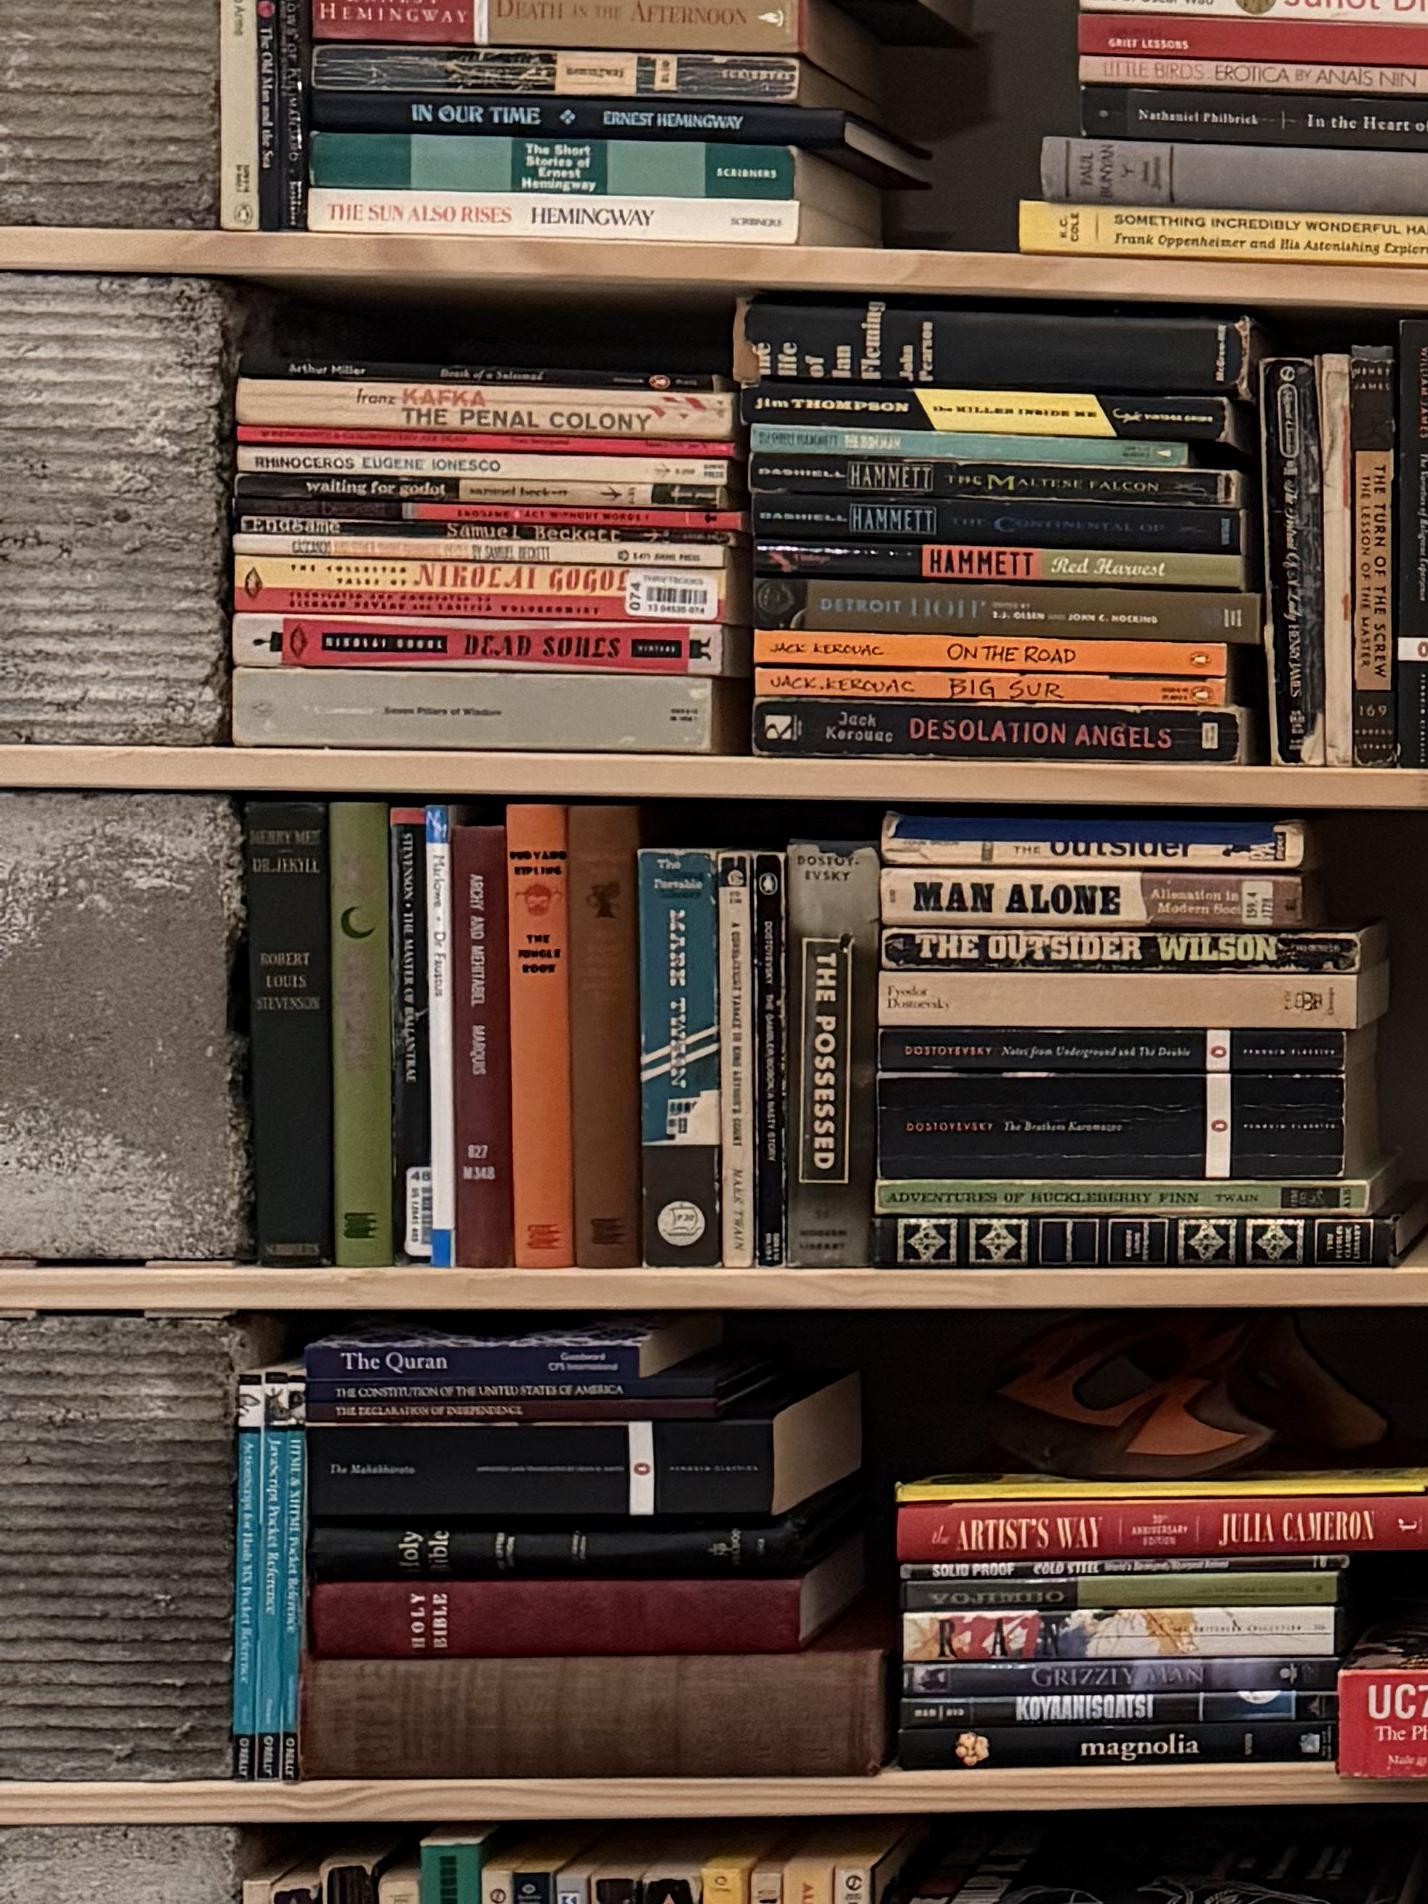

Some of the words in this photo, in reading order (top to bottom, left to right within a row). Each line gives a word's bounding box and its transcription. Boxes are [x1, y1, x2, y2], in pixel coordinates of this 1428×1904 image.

[403, 389, 485, 407] KAFKA
[403, 408, 447, 426] THE
[460, 409, 540, 427] PENAL
[550, 412, 650, 431] COLONY
[929, 551, 1034, 576] HAMMETT
[909, 718, 1070, 745] DESOLATION
[1075, 725, 1172, 749] ANGELS
[913, 882, 993, 913] MAN
[1005, 883, 1120, 914] ALONE
[814, 953, 836, 993] THE
[813, 1000, 836, 1171] POSSESSED
[341, 1353, 380, 1370] The
[386, 1352, 447, 1372] Quran
[957, 1518, 1048, 1549] ARTIST'S
[1057, 1517, 1102, 1548] WAY
[1220, 1512, 1273, 1544] JULIA
[1283, 1511, 1374, 1542] CAMERON
[1080, 1736, 1198, 1761] magnolia
